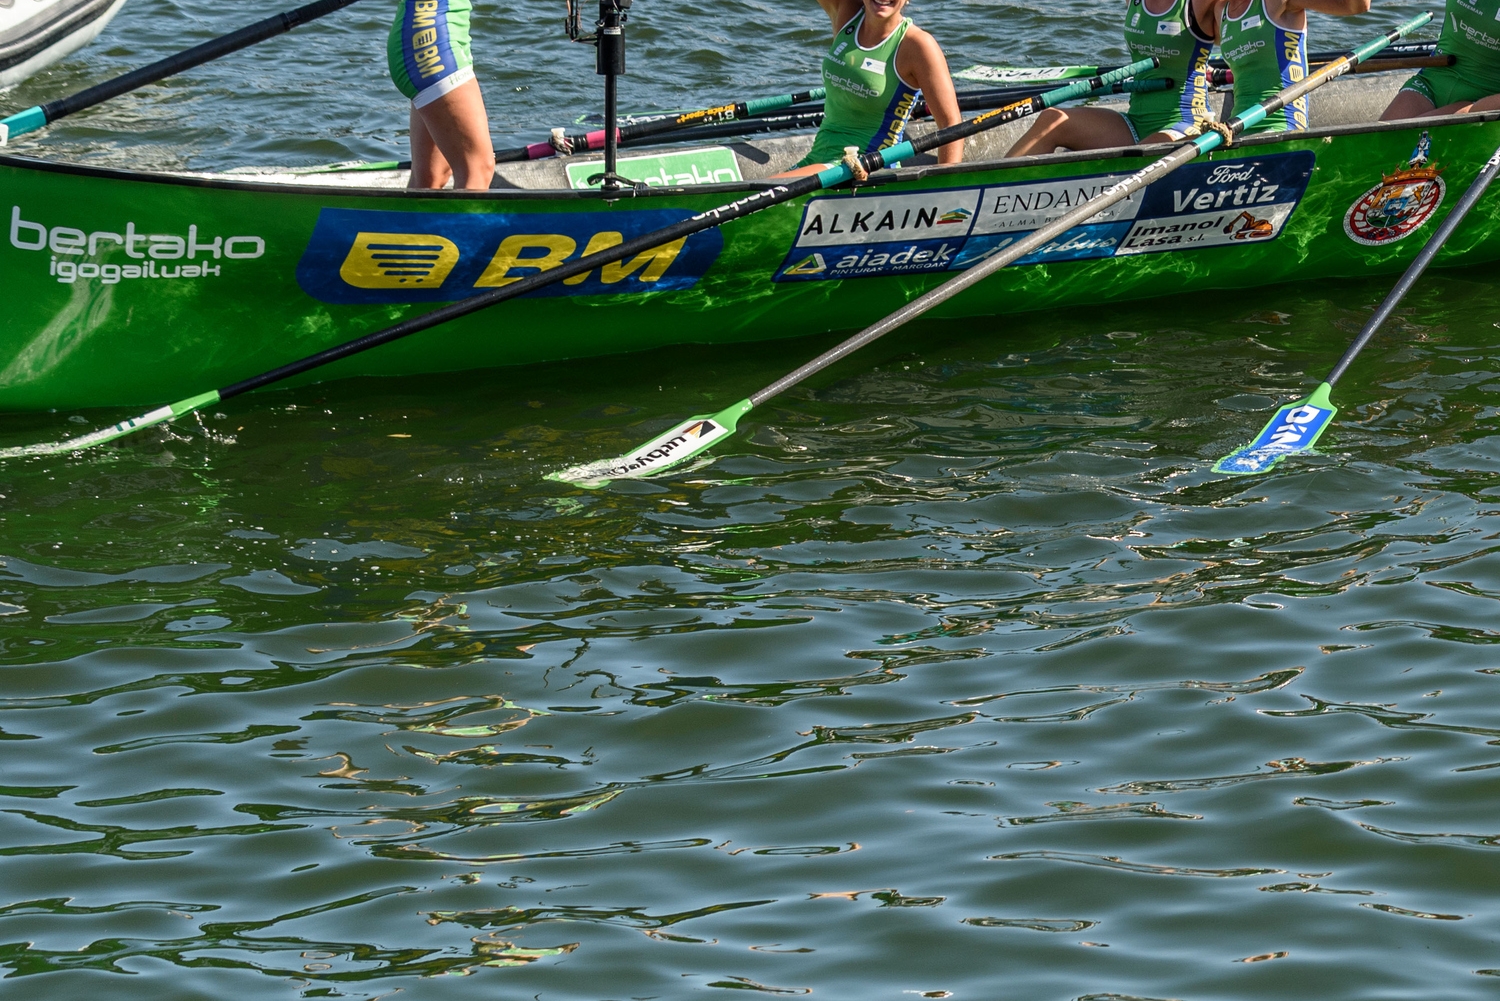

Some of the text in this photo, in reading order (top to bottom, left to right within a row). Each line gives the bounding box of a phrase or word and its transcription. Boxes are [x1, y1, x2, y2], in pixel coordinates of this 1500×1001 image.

[411, 0, 439, 29] BM
[1130, 41, 1181, 56] bertako
[1194, 47, 1210, 74] BM
[1224, 39, 1266, 60] bertako
[1283, 31, 1300, 64] BM
[413, 45, 446, 79] BM
[824, 69, 881, 98] bertako
[717, 109, 735, 122] B1
[895, 92, 915, 121] BM
[1014, 102, 1034, 116] E4
[1206, 163, 1255, 186] Ford
[993, 190, 1133, 215] ENDAN
[1172, 180, 1280, 213] Vertiz
[9, 205, 266, 260] bertako
[803, 206, 939, 236] ALKAIN
[1132, 216, 1225, 238] Imanol
[1124, 233, 1205, 249] Lasa s.l.
[473, 230, 689, 289] BM
[829, 265, 884, 276] PINTURAS
[892, 260, 948, 272] MARGOAK
[836, 243, 957, 269] aiadek
[49, 255, 222, 285] igogailuak
